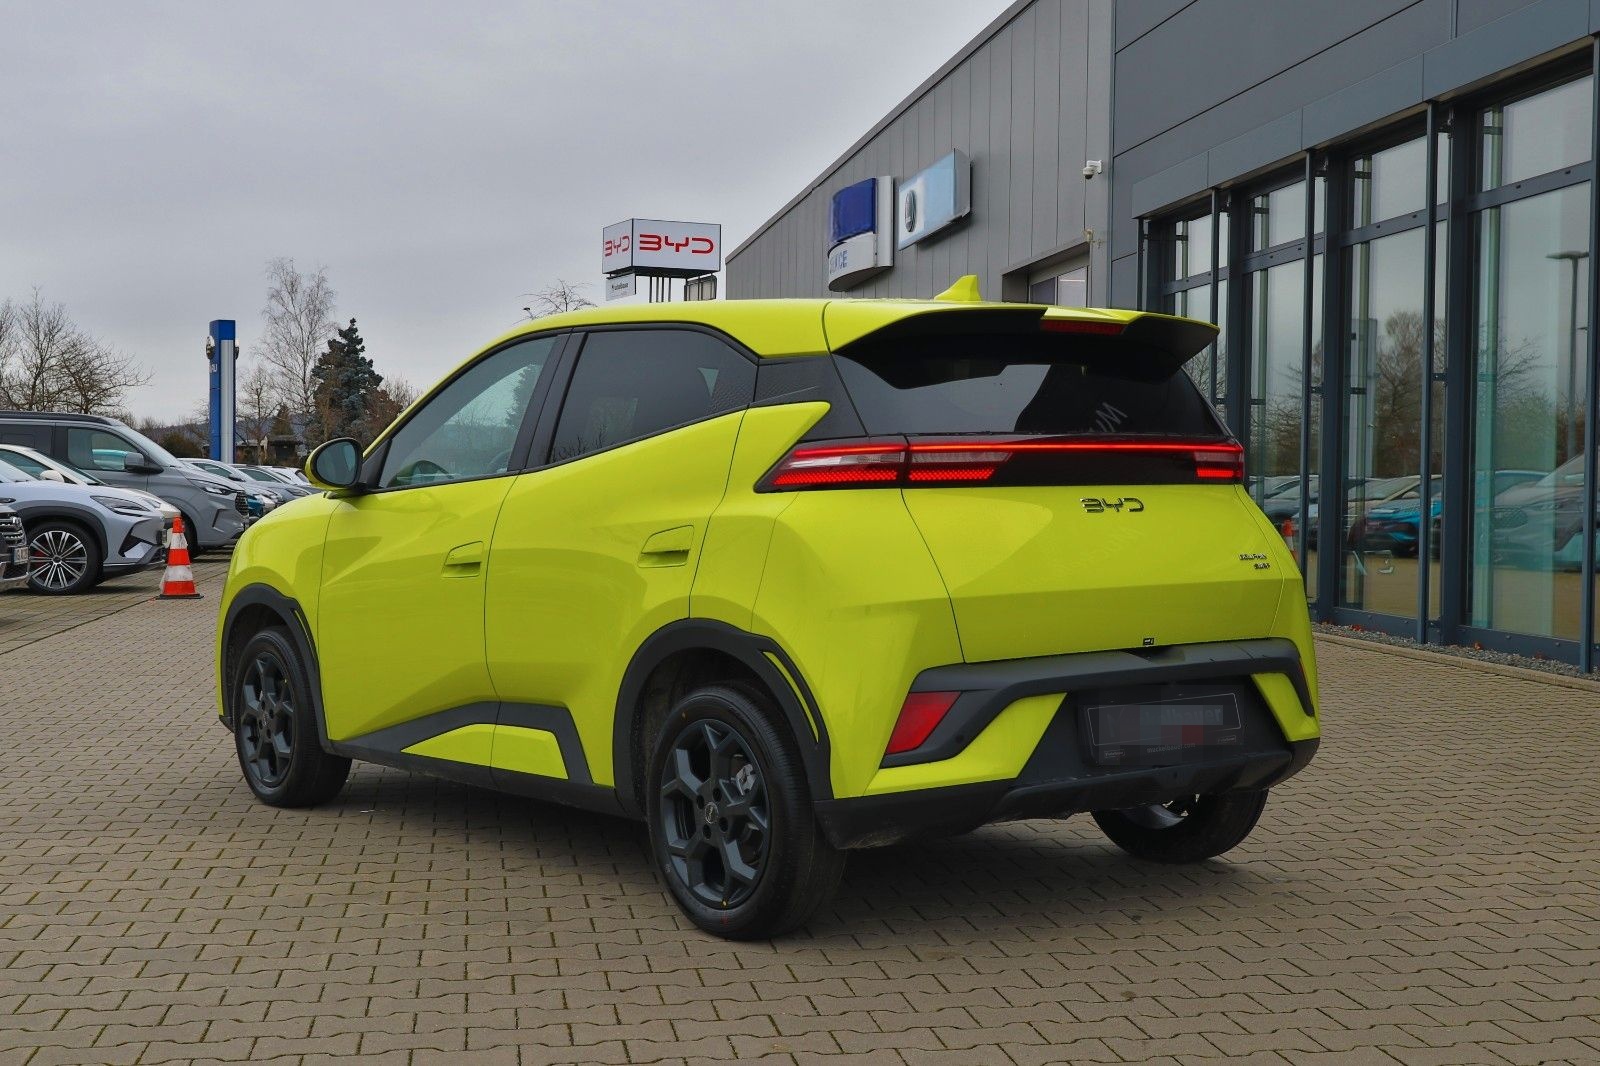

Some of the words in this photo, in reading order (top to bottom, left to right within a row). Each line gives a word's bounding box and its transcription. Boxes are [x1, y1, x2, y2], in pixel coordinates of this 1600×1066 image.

[605, 235, 630, 257] BYD
[639, 233, 714, 254] BYD
[1079, 497, 1145, 514] BYD
